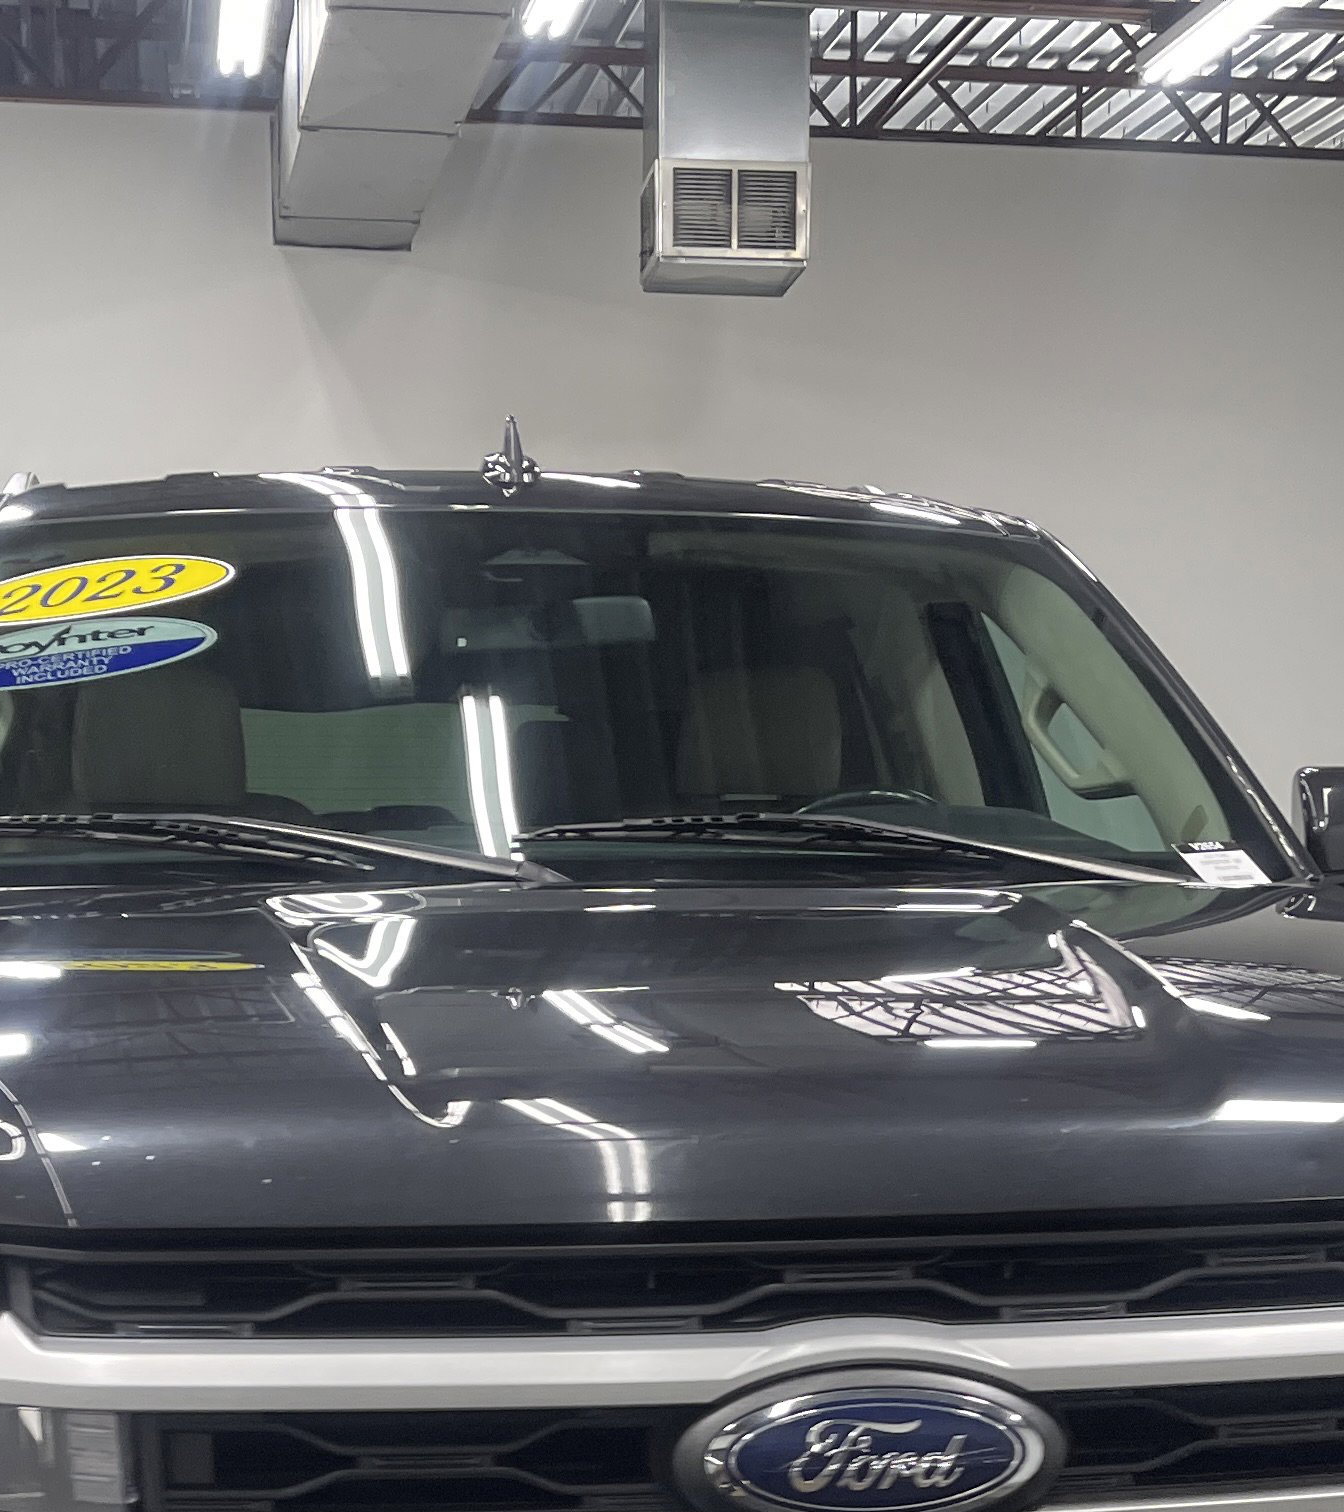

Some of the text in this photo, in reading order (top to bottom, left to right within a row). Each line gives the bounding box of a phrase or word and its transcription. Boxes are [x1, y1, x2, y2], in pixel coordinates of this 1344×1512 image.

[11, 655, 114, 677] WARRANTY
[16, 665, 108, 685] INCLUDED
[787, 1419, 968, 1493] Ford
